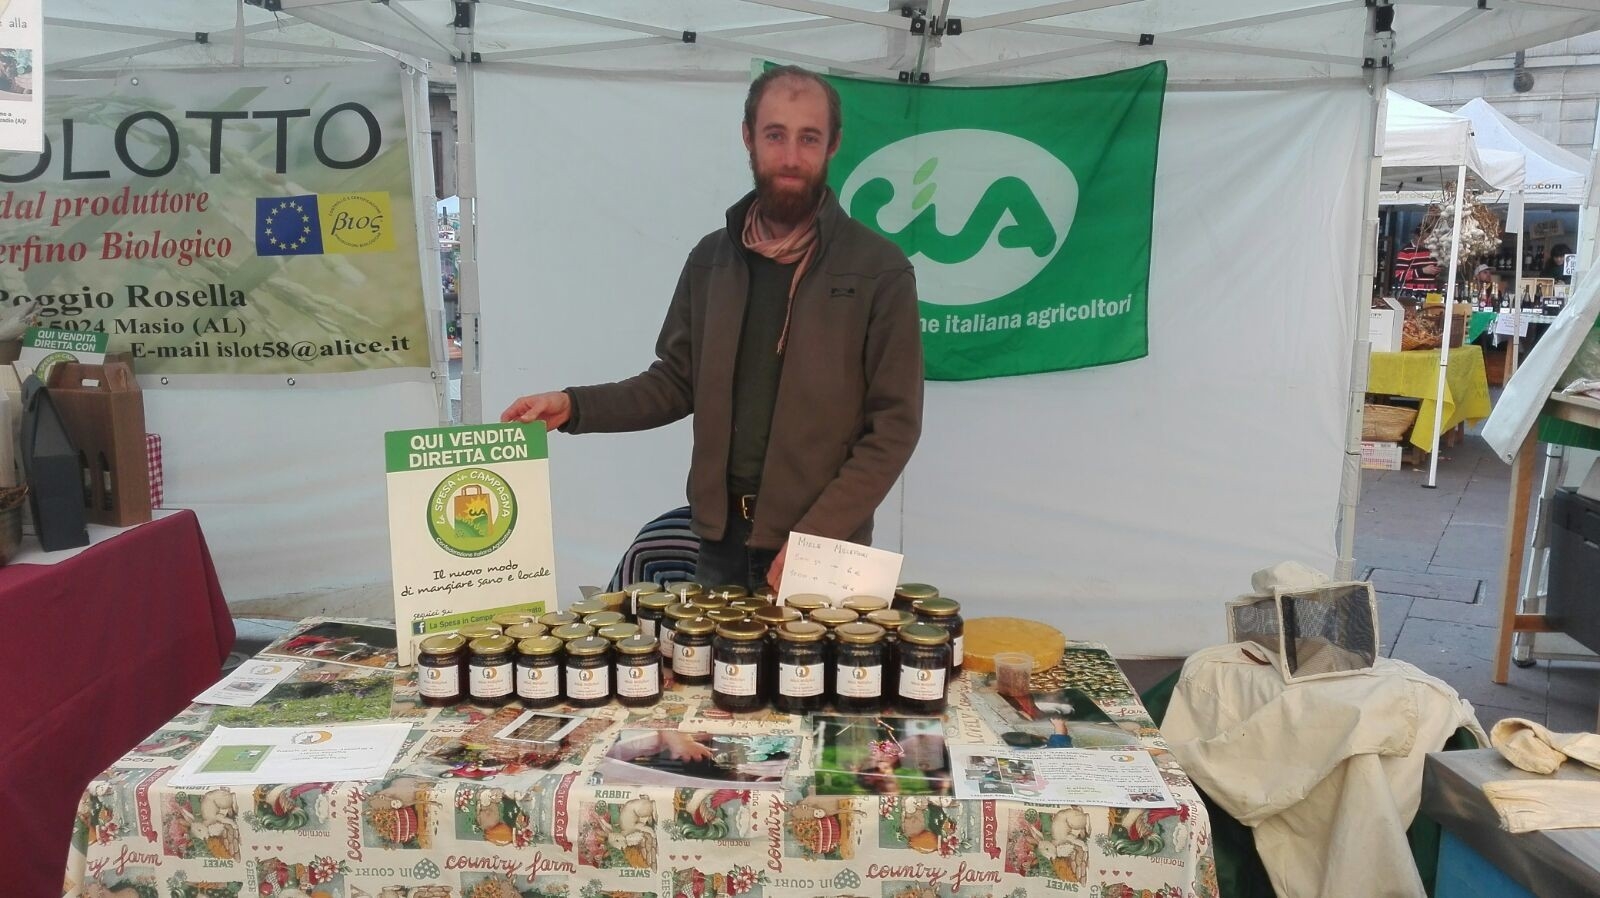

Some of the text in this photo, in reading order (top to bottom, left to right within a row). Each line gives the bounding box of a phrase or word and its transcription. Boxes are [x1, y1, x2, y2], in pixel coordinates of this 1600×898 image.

[9, 17, 27, 28] alla
[0, 186, 209, 226] dal produttore
[98, 229, 232, 266] Biologico
[125, 283, 247, 308] Rosella
[945, 313, 1022, 333] italiana
[1026, 294, 1133, 329] agricoltori
[37, 330, 97, 343] QUI VENDITA
[38, 317, 246, 337] 5024 Masio (AL)
[34, 339, 96, 352] DIRETTA CON
[130, 335, 411, 362] E-mail islot58@alice.it
[410, 427, 526, 451] QUI VENDITA
[409, 444, 528, 468] DIRETTA CON
[435, 480, 456, 512] SPESA
[470, 471, 511, 518] CAMPAGNA
[401, 567, 551, 597] di mangiare sano e locale
[433, 560, 519, 581] Il nuovo modo
[413, 608, 440, 620] seguici
[429, 622, 438, 630] La
[439, 617, 461, 628] Spesa
[462, 617, 470, 625] in
[470, 613, 497, 623] Campa
[595, 789, 631, 799] RABBIT
[765, 791, 788, 873] country
[985, 824, 994, 848] CATS
[112, 844, 163, 877] farm
[202, 859, 234, 868] SWEET
[355, 868, 395, 876] COURT
[445, 850, 577, 884] country farm
[619, 869, 651, 878] SWEET
[774, 879, 814, 889] COURT
[865, 860, 1001, 893] country farm
[1047, 880, 1079, 893] SWEET
